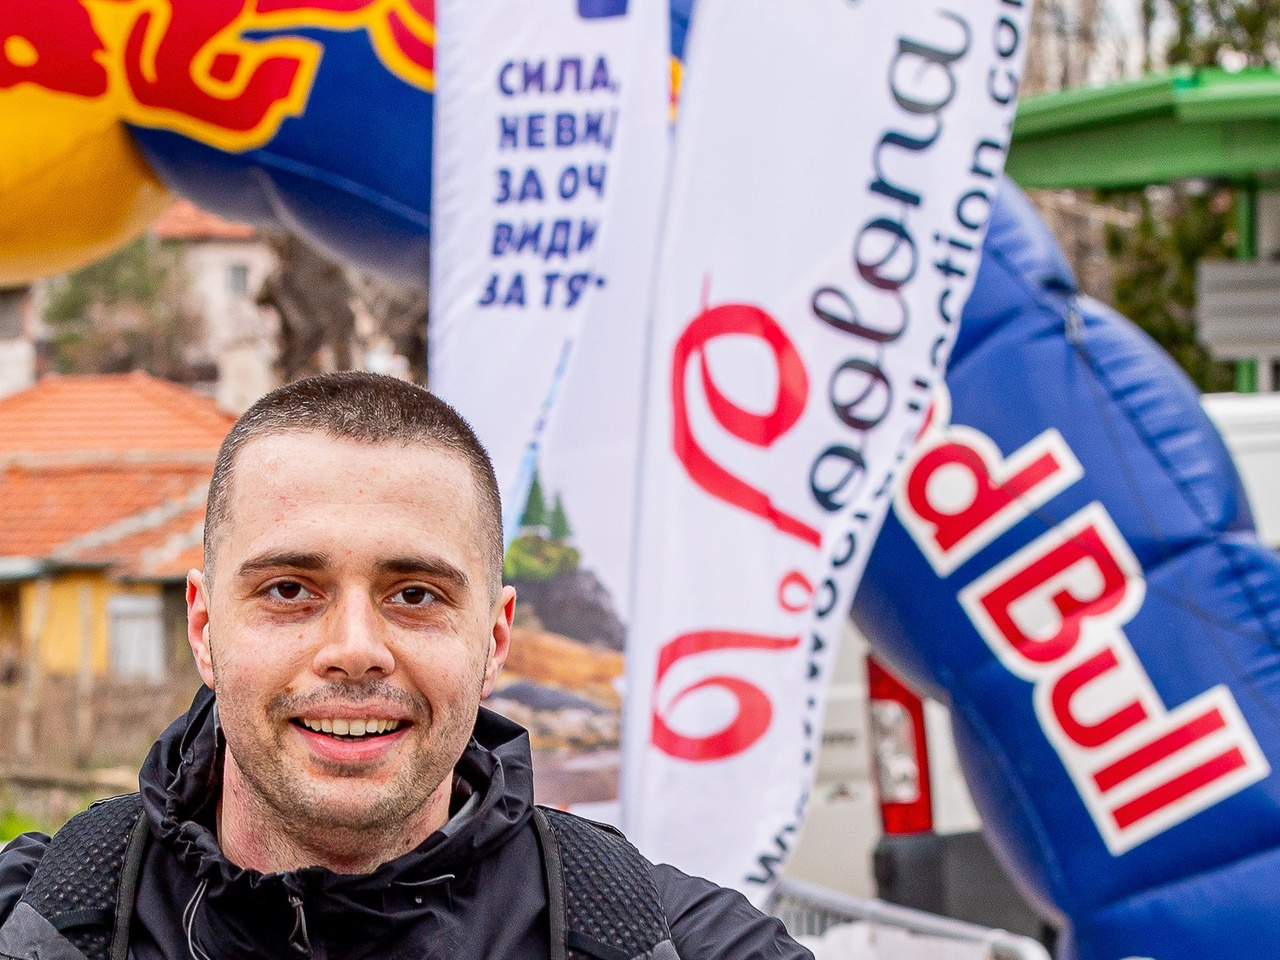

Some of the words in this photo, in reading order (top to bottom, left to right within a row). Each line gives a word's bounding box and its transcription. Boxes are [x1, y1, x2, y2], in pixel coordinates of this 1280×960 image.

[494, 166, 545, 204] ЗА
[477, 272, 526, 309] ЗА
[972, 520, 1254, 836] Bull
